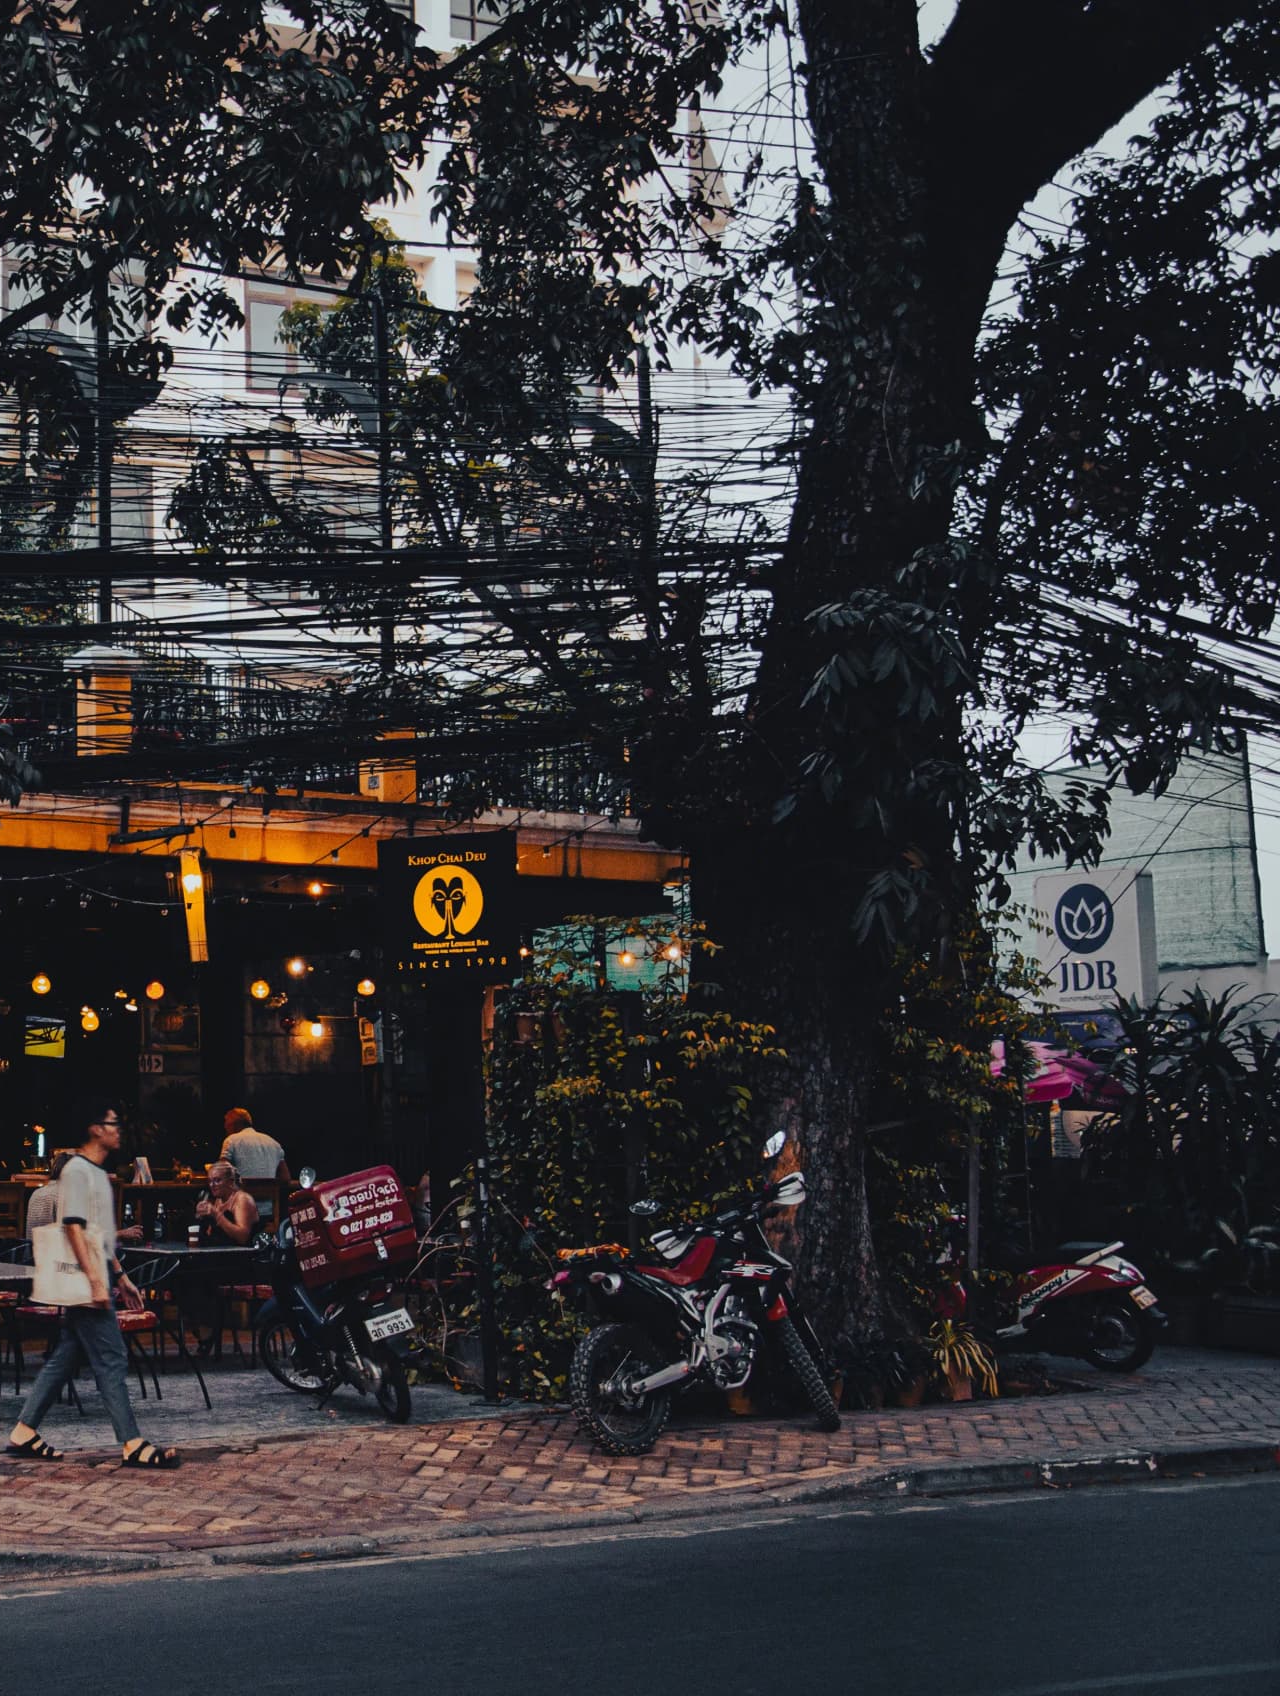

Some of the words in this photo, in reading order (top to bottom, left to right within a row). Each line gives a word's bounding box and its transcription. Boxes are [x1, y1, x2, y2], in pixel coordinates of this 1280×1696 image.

[408, 856, 436, 866] KHOP
[438, 853, 462, 863] CHAI
[466, 852, 486, 862] DEU
[398, 960, 450, 970] SINCE
[466, 957, 508, 967] 1998
[1059, 960, 1118, 993] JDB
[350, 1220, 363, 1233] 021
[387, 1318, 411, 1334] 9931
